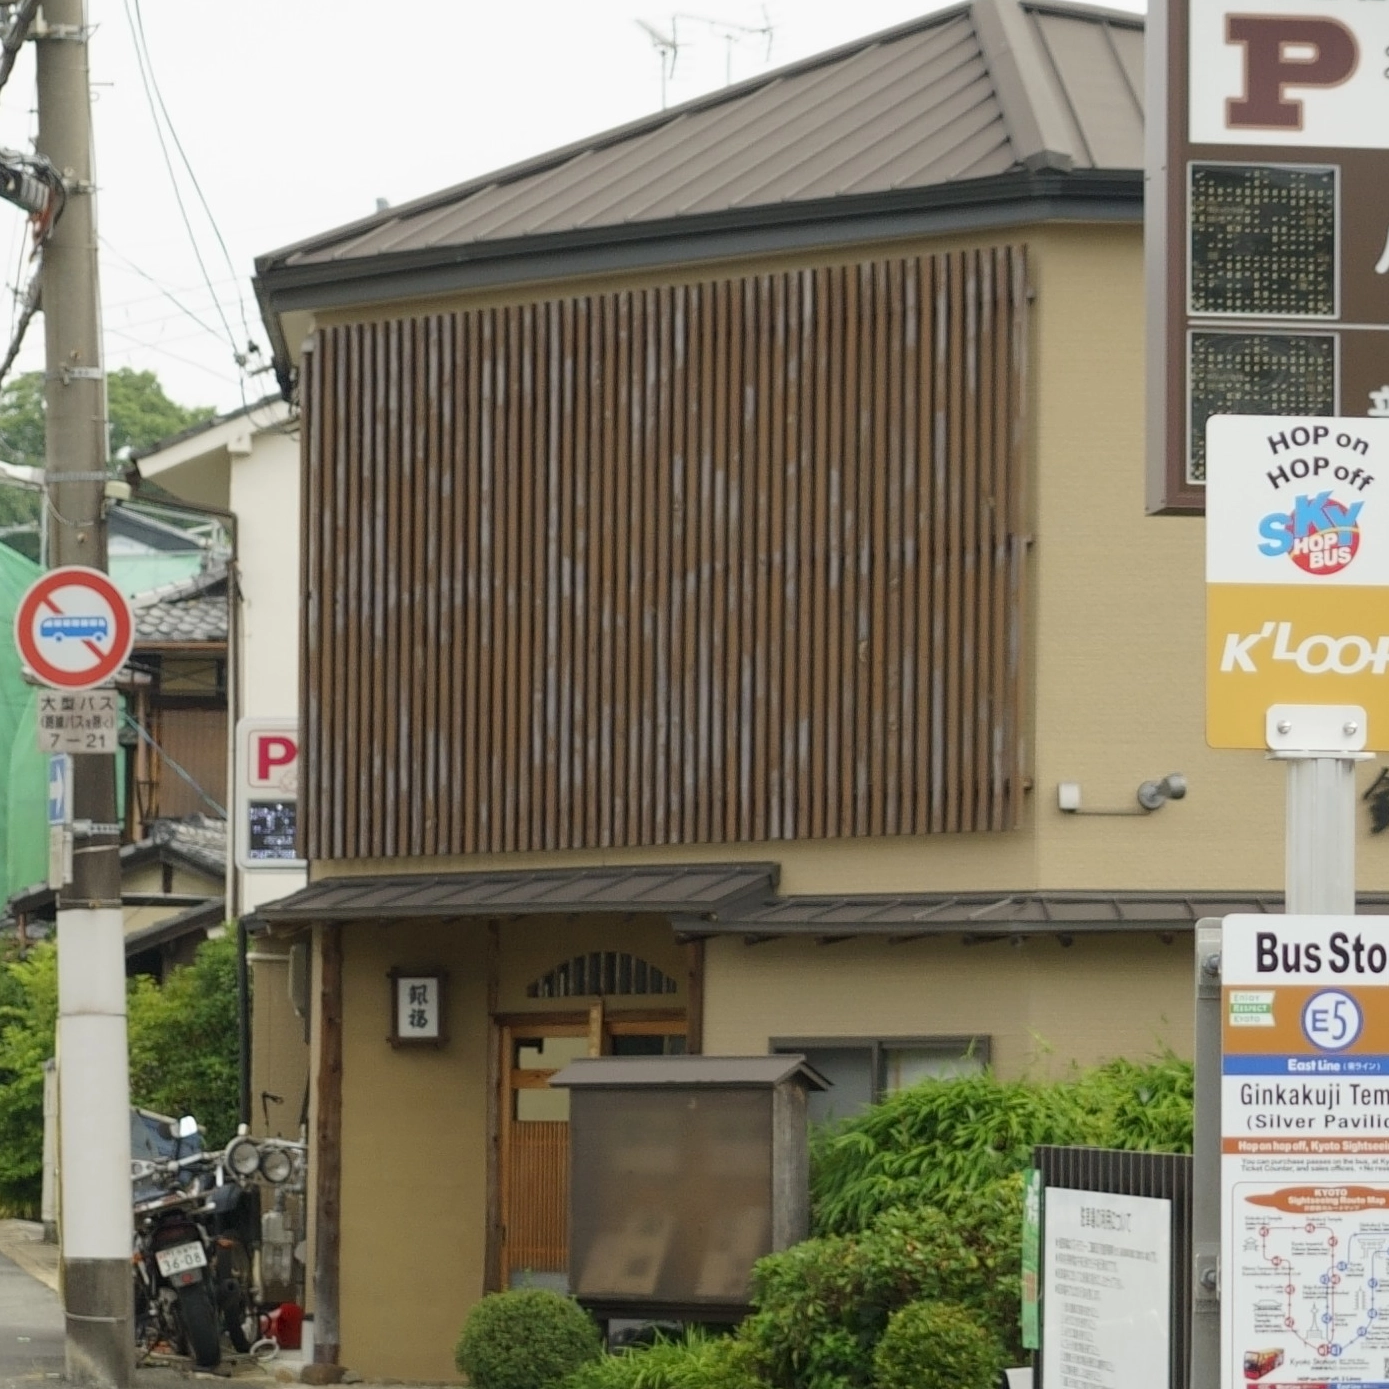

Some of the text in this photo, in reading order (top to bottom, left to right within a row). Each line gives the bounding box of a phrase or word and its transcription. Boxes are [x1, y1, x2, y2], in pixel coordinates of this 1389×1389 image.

[1224, 12, 1360, 131] P
[1267, 425, 1370, 455] HOP on
[1266, 456, 1375, 492] HOP off
[1257, 490, 1365, 557] SKY
[1293, 533, 1339, 555] HOP
[1309, 546, 1353, 569] BUS
[41, 697, 113, 711] 大型バス
[258, 736, 298, 780] P
[1256, 932, 1321, 973] Bus
[1311, 1000, 1348, 1041] E5
[1287, 1058, 1316, 1072] East
[1318, 1059, 1341, 1072] Line
[1241, 1083, 1340, 1110] Ginkakuji
[1247, 1114, 1315, 1130] (Silver
[1238, 1140, 1258, 1152] Hop
[1259, 1142, 1272, 1151] on
[1273, 1140, 1292, 1152] hop
[1310, 1140, 1341, 1153] Kyoto
[1288, 1196, 1386, 1206] Sightseeing Route Map
[1314, 1188, 1348, 1197] KYOTO
